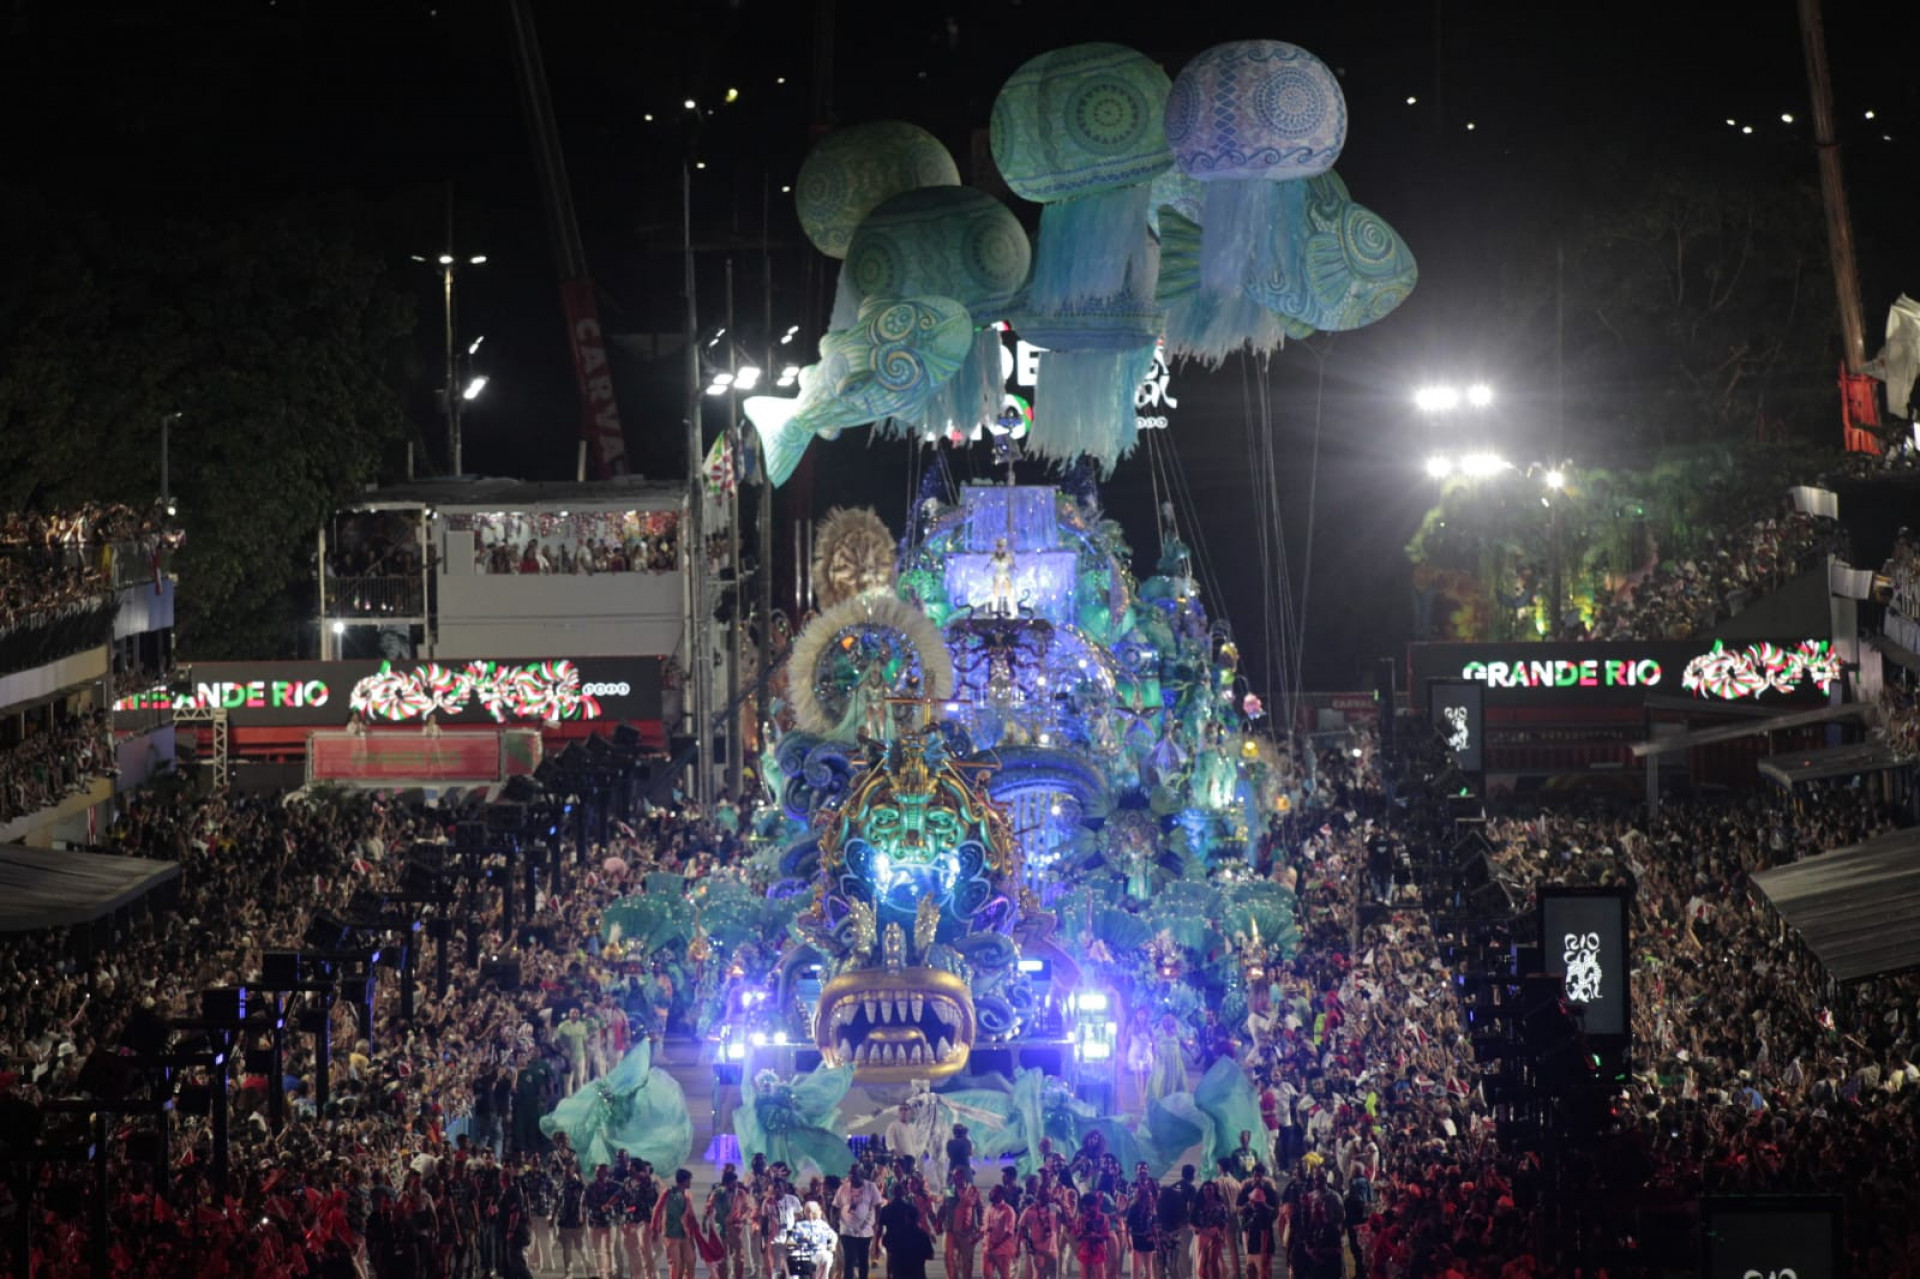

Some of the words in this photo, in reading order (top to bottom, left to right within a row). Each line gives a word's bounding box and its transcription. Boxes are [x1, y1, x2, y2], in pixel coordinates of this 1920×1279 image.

[1463, 659, 1599, 688] GRANDE
[1605, 658, 1663, 687] RIO
[272, 679, 329, 708] RIO
[1565, 932, 1600, 950] RIO
